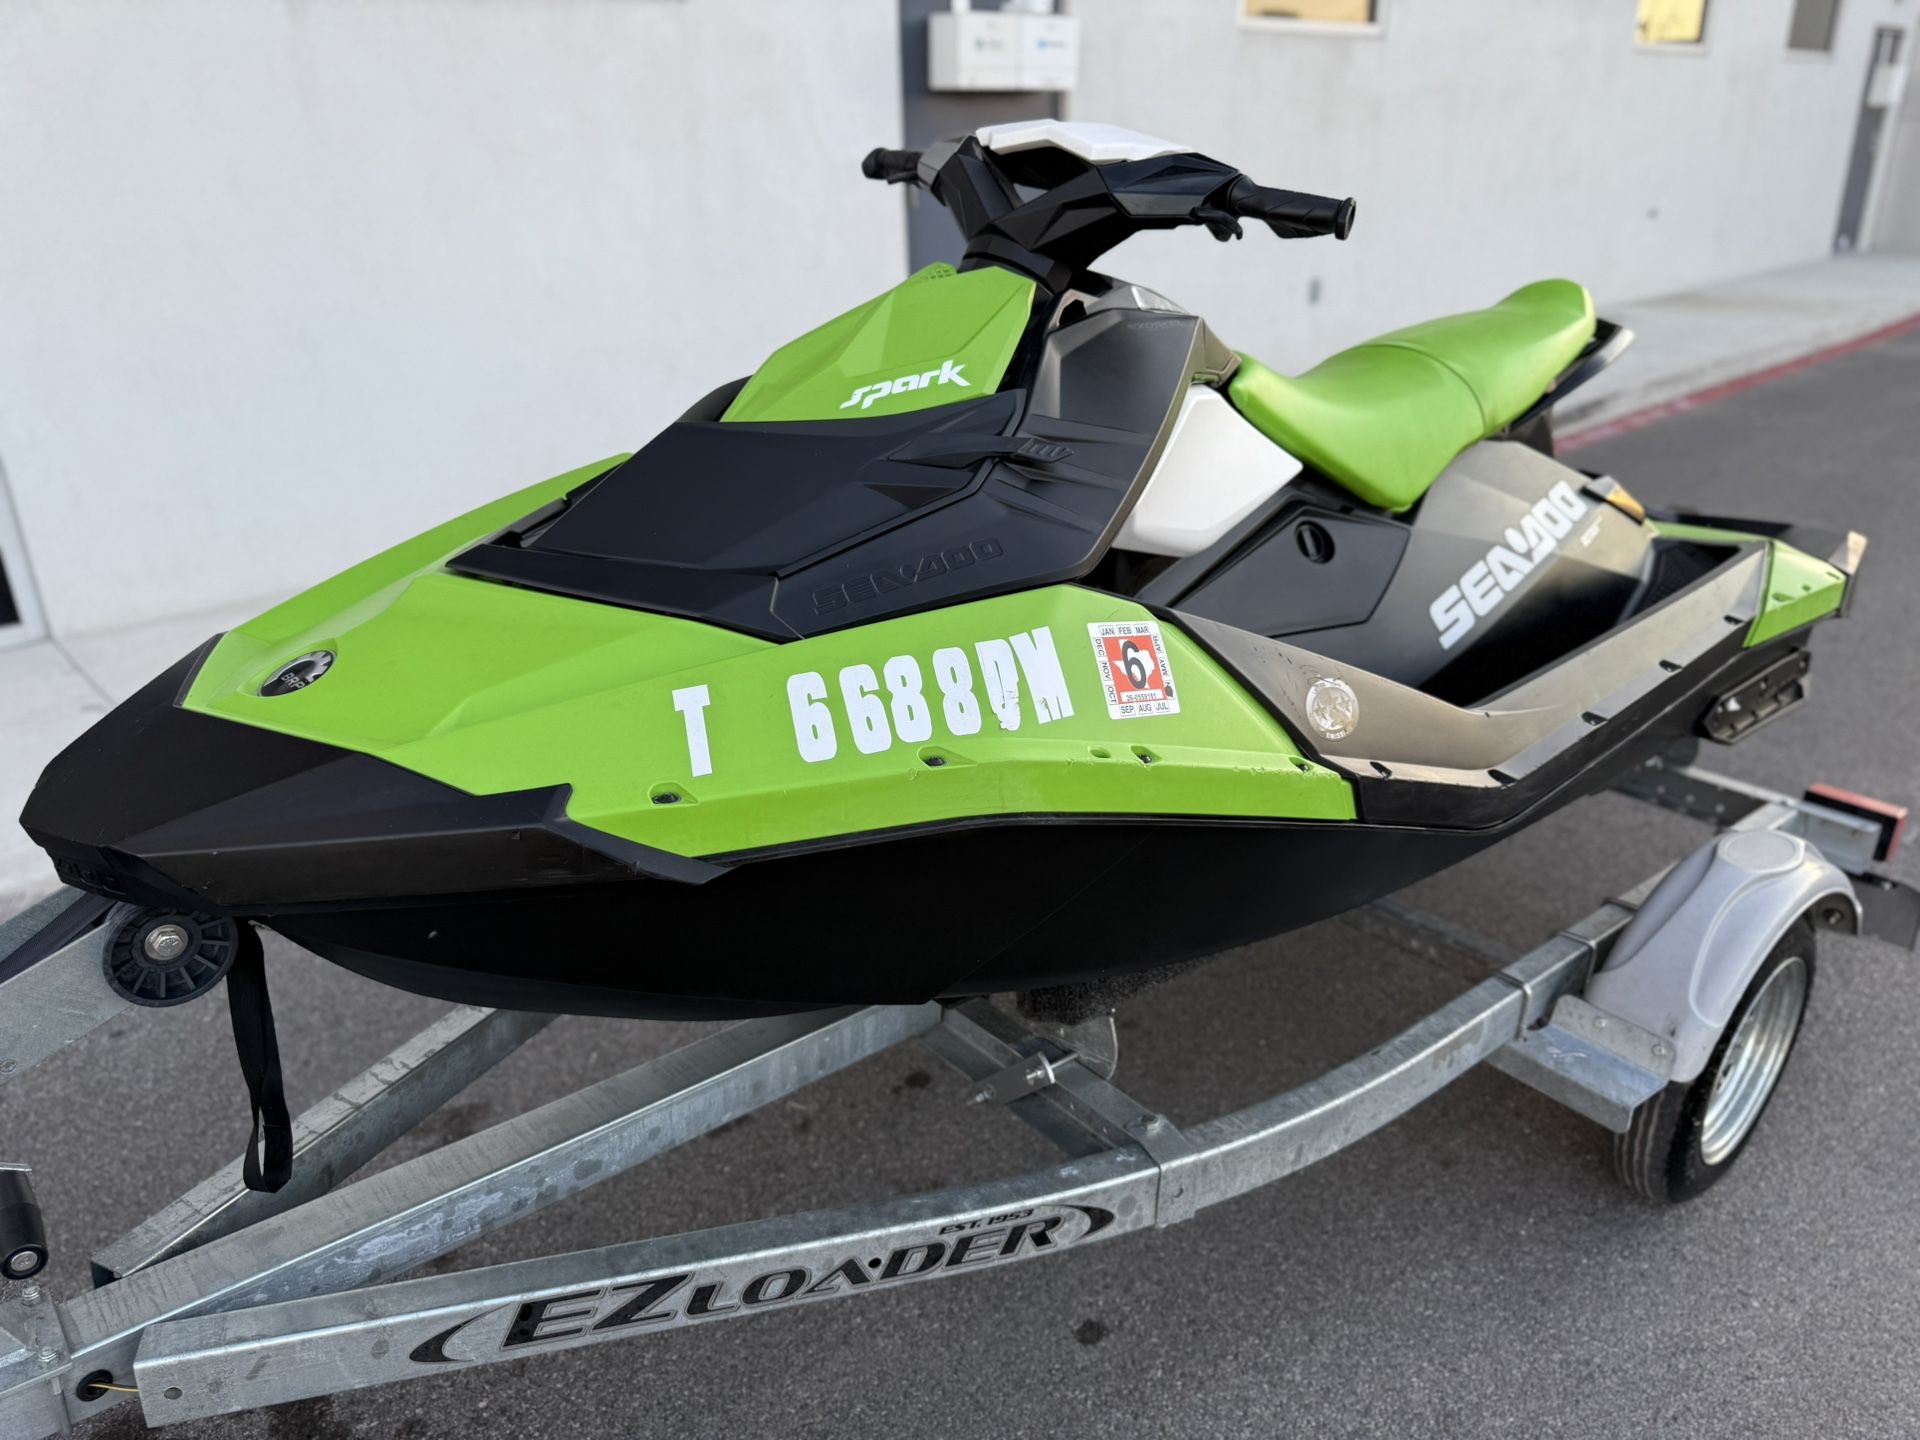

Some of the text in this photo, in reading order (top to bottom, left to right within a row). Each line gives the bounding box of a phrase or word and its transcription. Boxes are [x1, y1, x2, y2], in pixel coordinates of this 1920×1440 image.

[840, 360, 971, 410] spark
[1101, 626, 1149, 636] JAN FEB MAR
[1095, 638, 1105, 657] DEC
[1153, 635, 1162, 653] APR
[1102, 662, 1111, 680] NOV
[1122, 640, 1146, 689] 6
[1160, 658, 1168, 676] MAY
[281, 672, 305, 689] BRP
[1107, 686, 1117, 703] OCT
[1121, 702, 1169, 714] SEP AUG JUL
[672, 684, 713, 777] T
[939, 1208, 1034, 1235] EST. 1953
